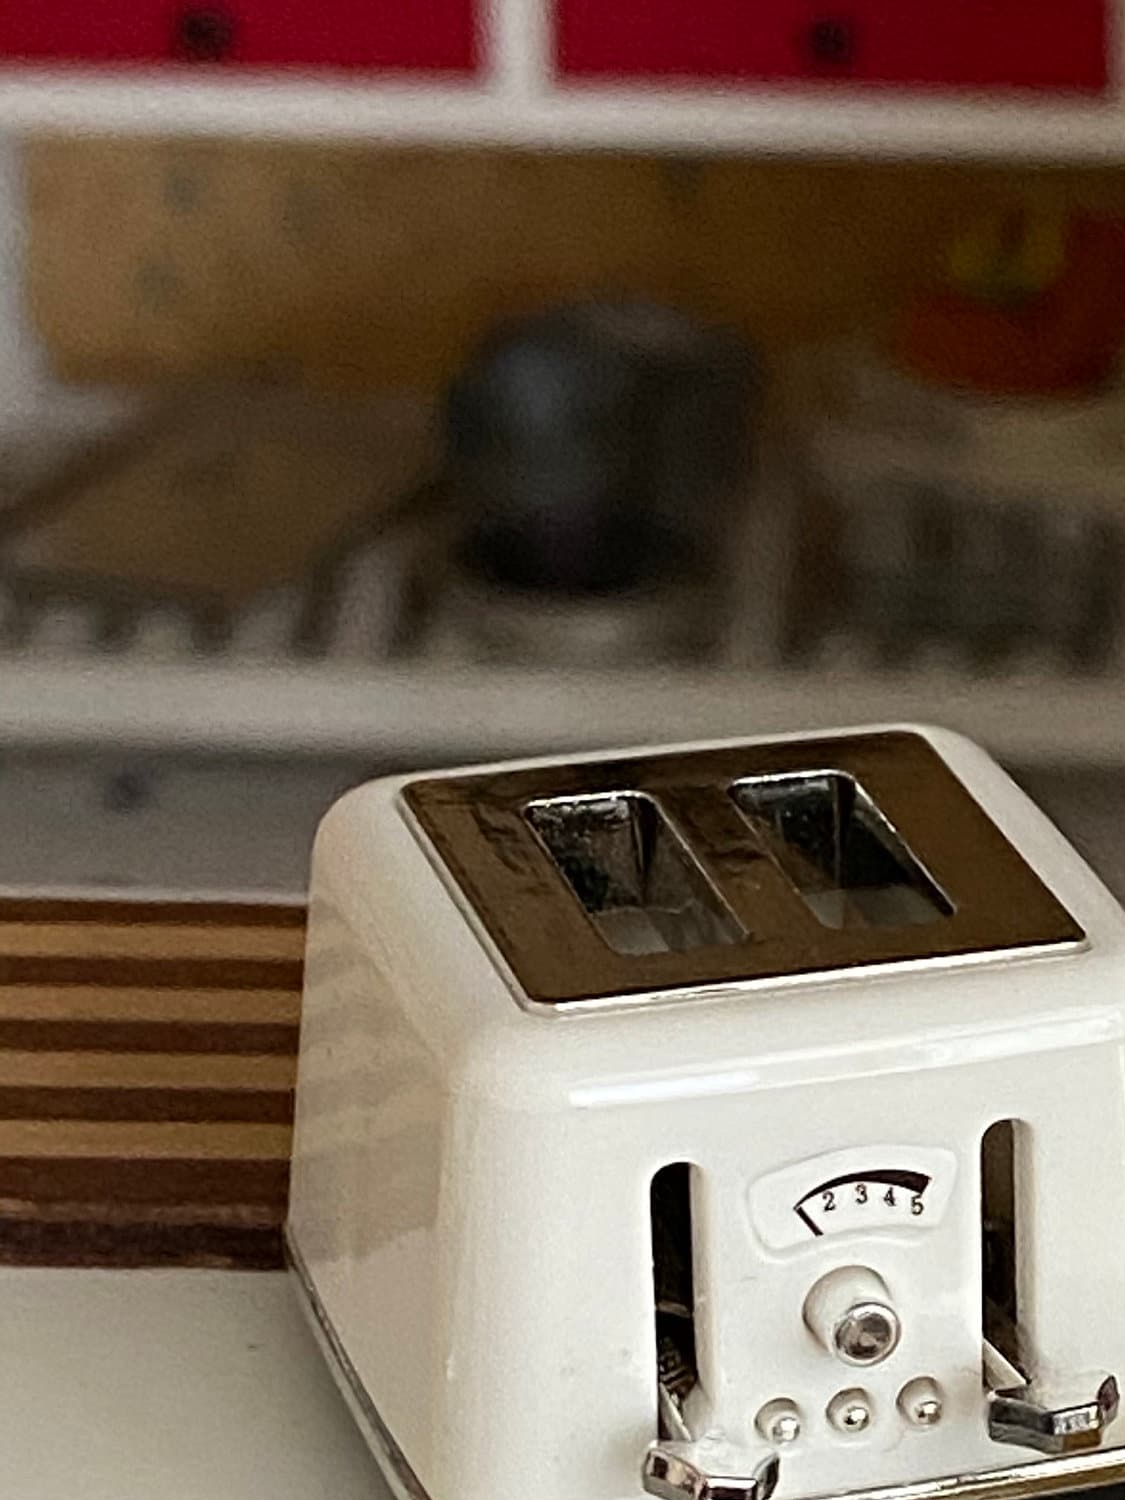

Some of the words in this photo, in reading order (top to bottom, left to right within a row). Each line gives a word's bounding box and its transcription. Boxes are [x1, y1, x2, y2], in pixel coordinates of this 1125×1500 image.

[822, 1190, 836, 1213] 2
[855, 1183, 868, 1204] 3
[883, 1186, 897, 1207] 4
[911, 1194, 924, 1215] 5
